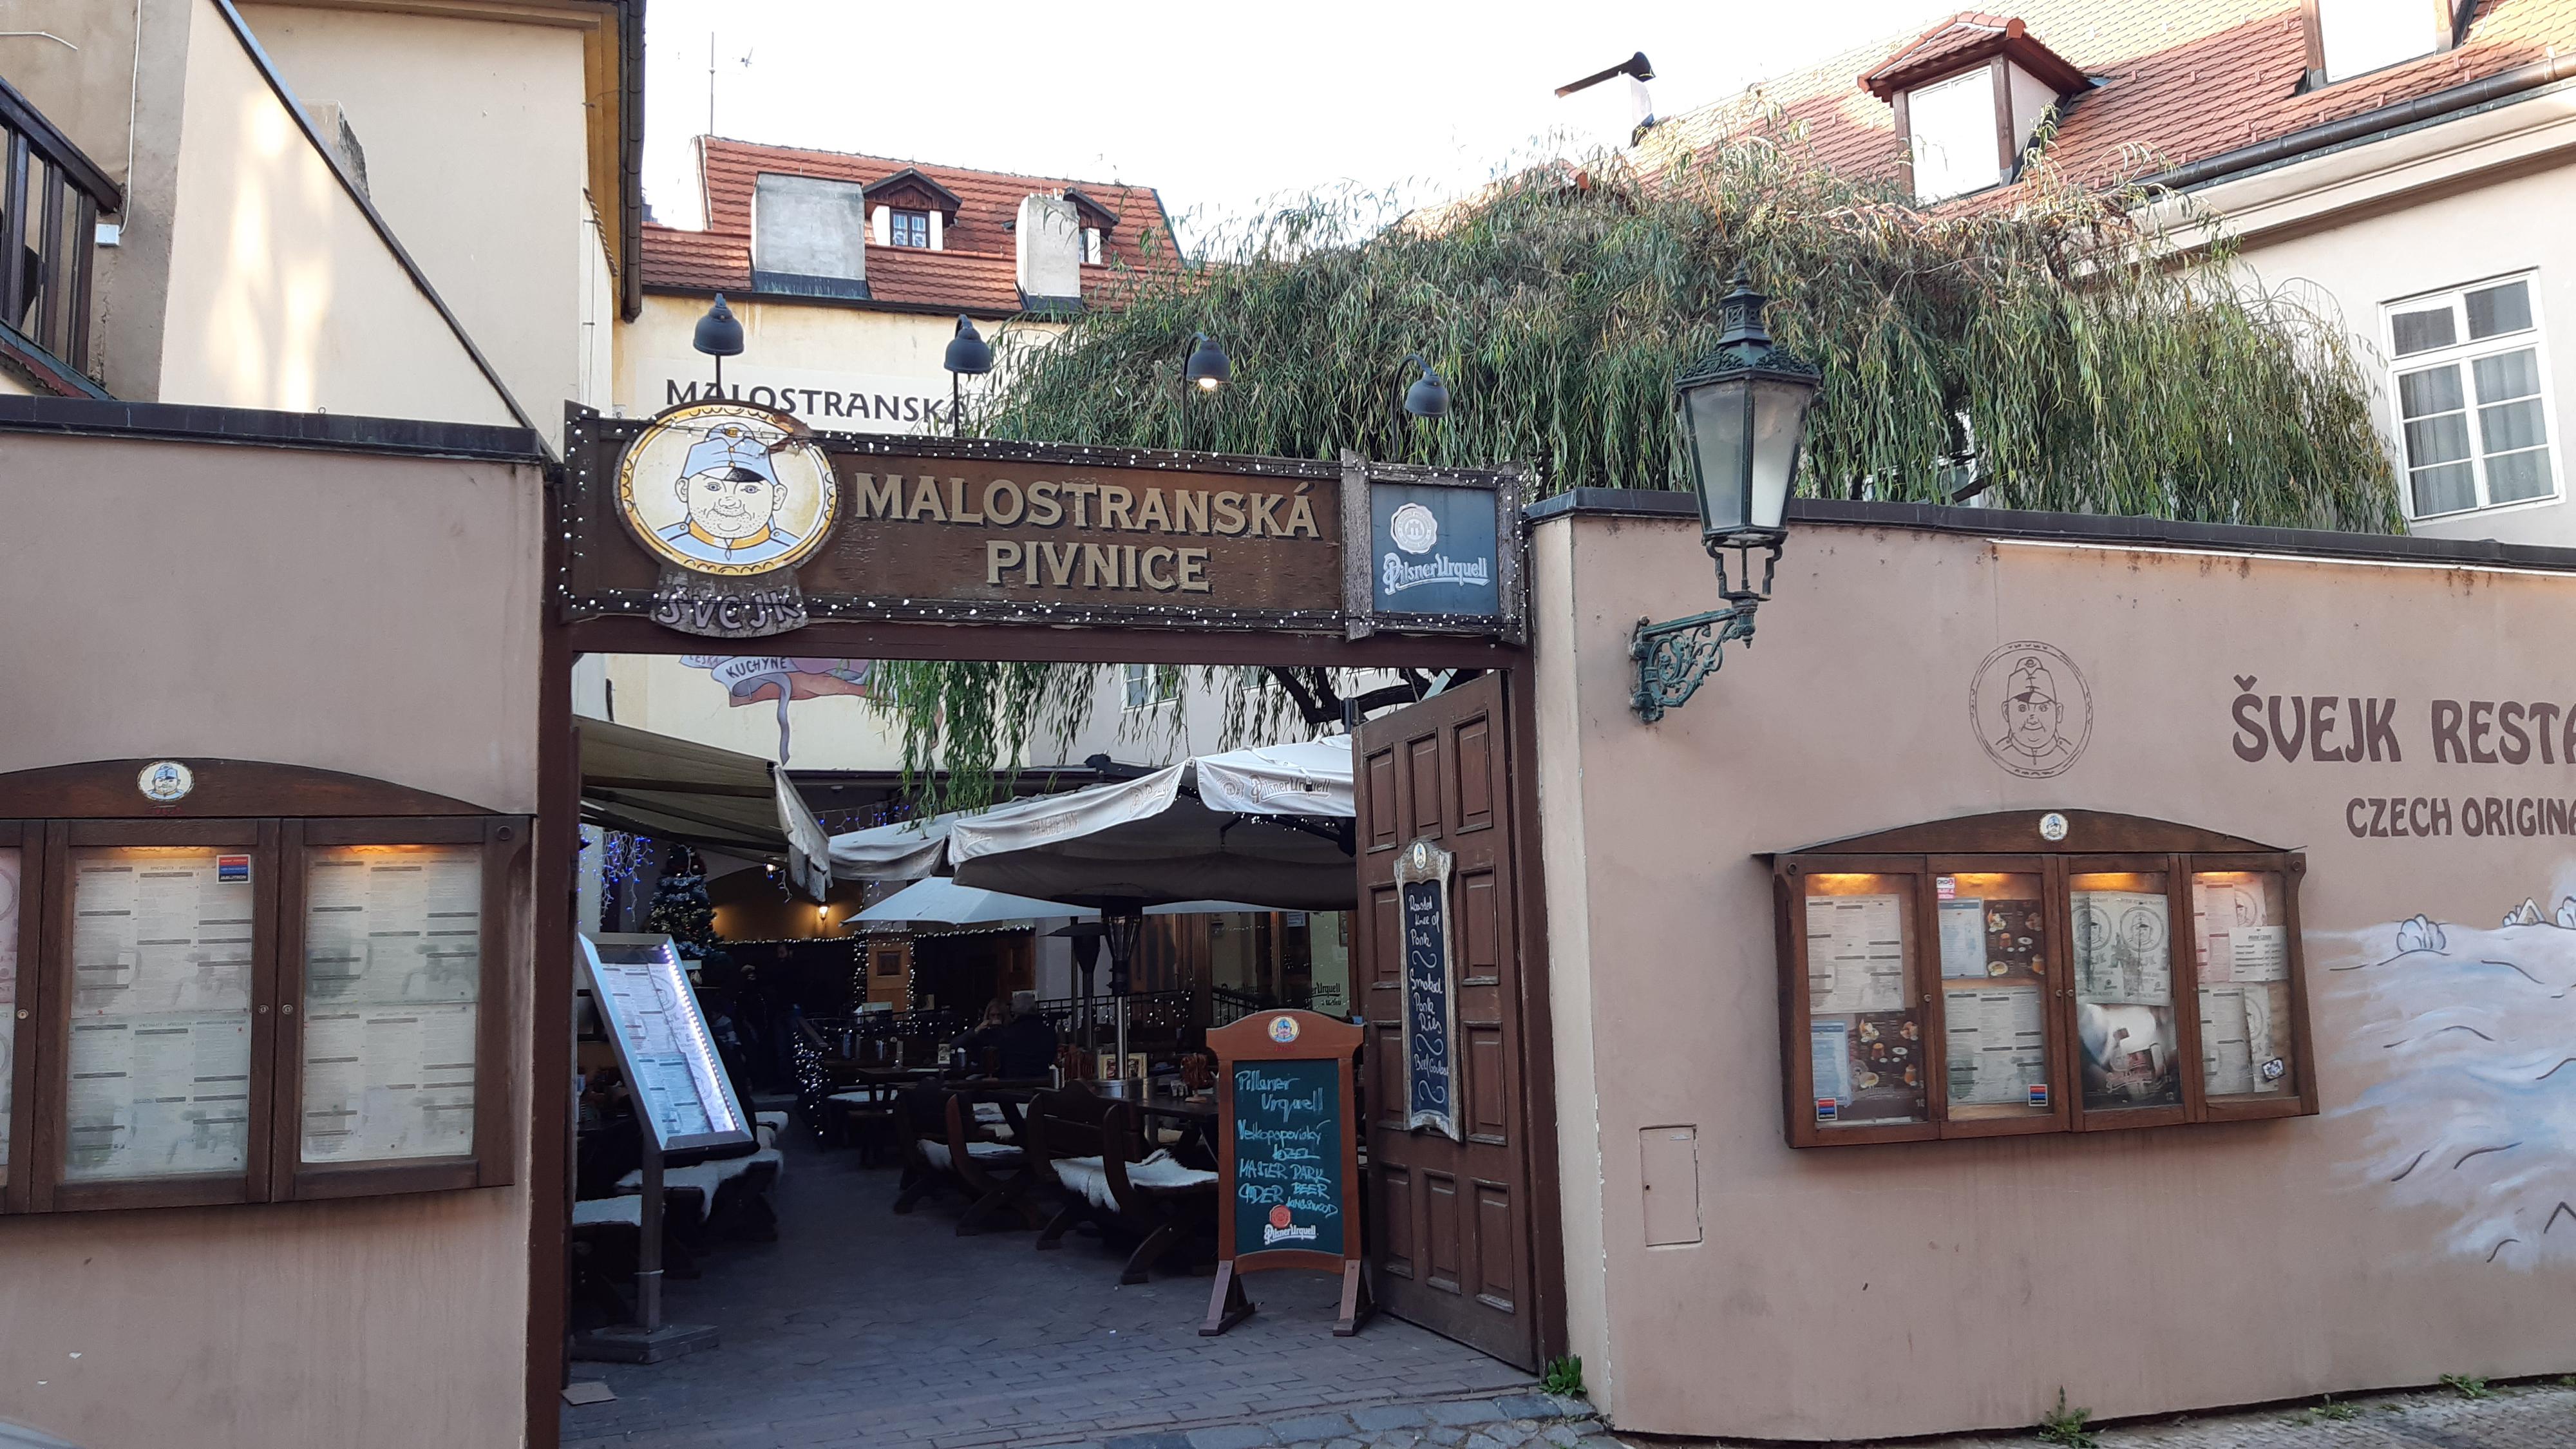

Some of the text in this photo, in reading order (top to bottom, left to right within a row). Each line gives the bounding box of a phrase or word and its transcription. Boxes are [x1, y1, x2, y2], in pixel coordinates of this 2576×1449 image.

[855, 471, 1320, 538] MALOSTRANSKÁ
[986, 540, 1211, 593] PIVNICE
[1383, 552, 1488, 595] Pilsner Urquell
[2231, 674, 2401, 763] ŠVEJK
[2346, 797, 2452, 838] CZECH
